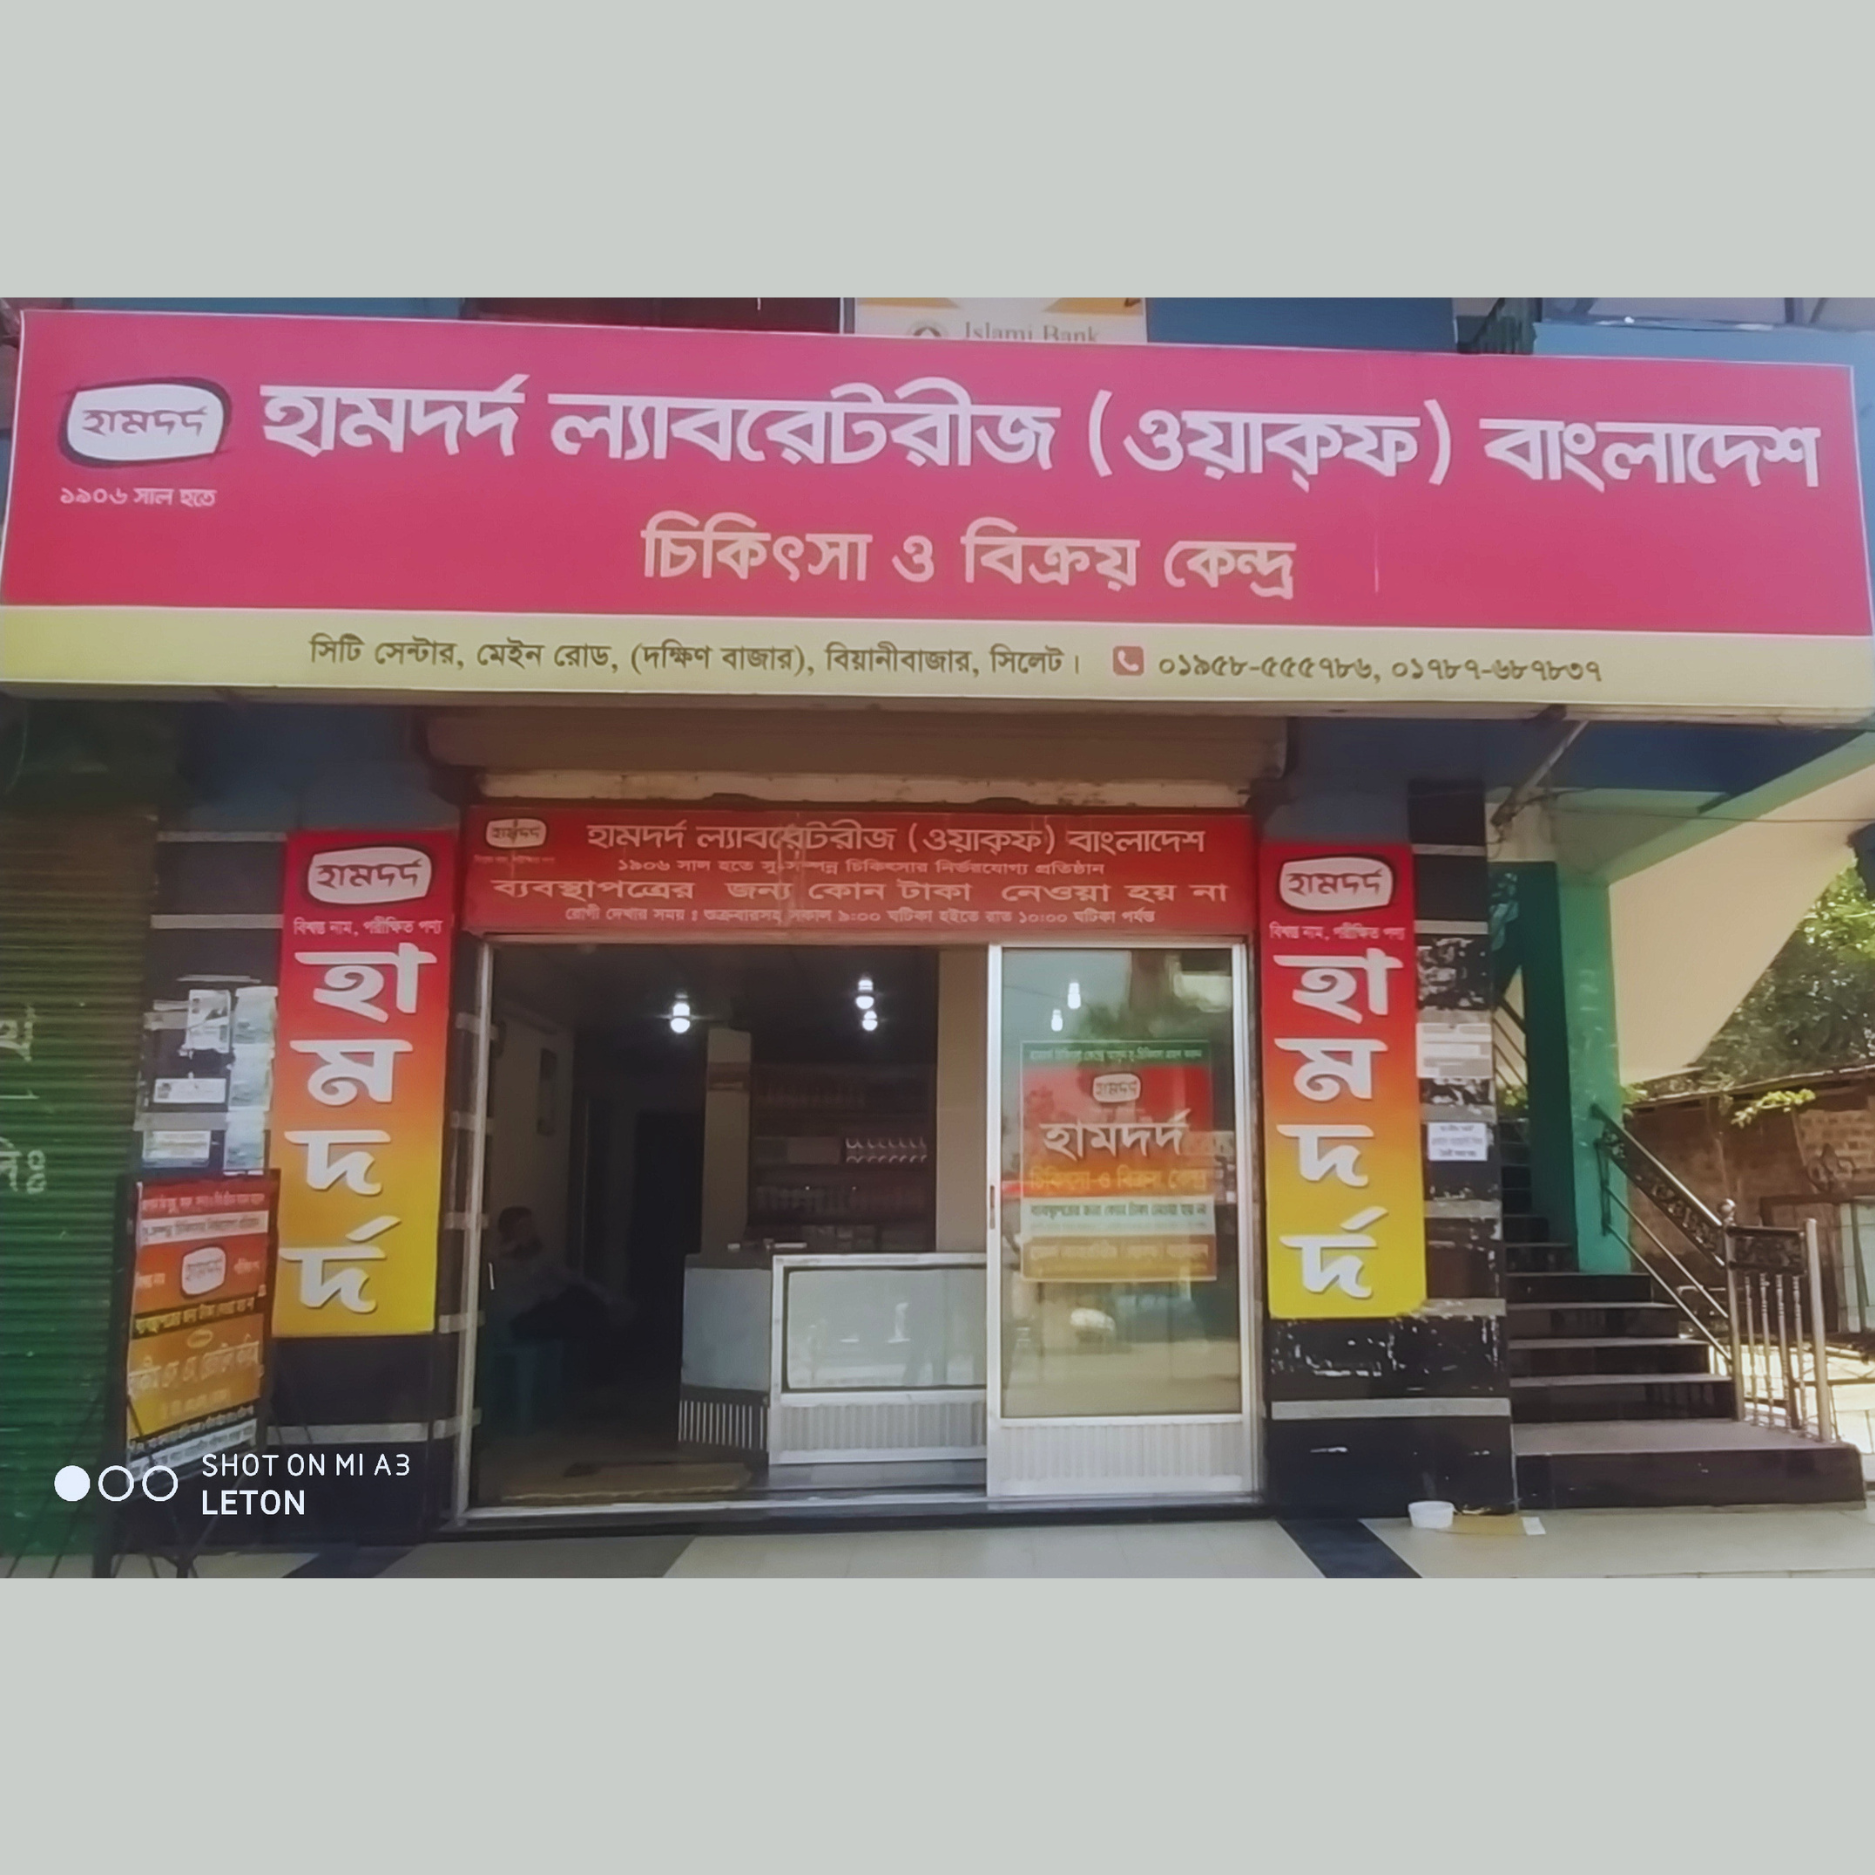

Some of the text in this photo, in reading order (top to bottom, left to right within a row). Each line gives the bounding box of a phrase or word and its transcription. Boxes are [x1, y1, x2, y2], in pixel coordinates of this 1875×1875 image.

[965, 321, 1033, 340] Islami
[81, 406, 208, 438] হামদর্দ
[260, 374, 530, 457] হামদর্দ
[548, 377, 1061, 470] ল্যাবরেটরীজ
[1479, 418, 1822, 493] বাংলাদেশ
[60, 487, 216, 508] ১৯০৬ সাল হতে
[641, 511, 1297, 600] চিকিৎসা ও বিক্রয় কেন্দ্র
[309, 633, 362, 664] সিটি
[375, 637, 465, 670] সেন্টার,
[476, 637, 545, 669] মেইন
[554, 640, 619, 673] রোড,
[631, 641, 711, 676] (দক্ষিণ
[722, 645, 815, 677] বাজার),
[826, 642, 979, 677] বিয়ানীবাজার,
[1159, 657, 1382, 684] ০১৯৫৮-৫৫৫৭৮৬,
[1392, 660, 1602, 683] ০১৭৮৭-৬৮৭৮৩৭
[587, 820, 687, 848] হামদর্দ
[696, 819, 896, 851] ল্যাবরেটরীজ
[1067, 830, 1206, 855] বাংলাদেশ
[316, 859, 423, 889] হামদর্দ
[618, 860, 671, 872] ১৯০৬
[677, 860, 711, 872] সাল
[717, 861, 754, 872] হতে
[490, 879, 1229, 903] ব্যবস্থাপত্রের জন্য কোন টাকা নেওয়া হয় না
[1287, 868, 1383, 898] হামদর্দ
[1039, 1108, 1192, 1161] হামদর্দ
